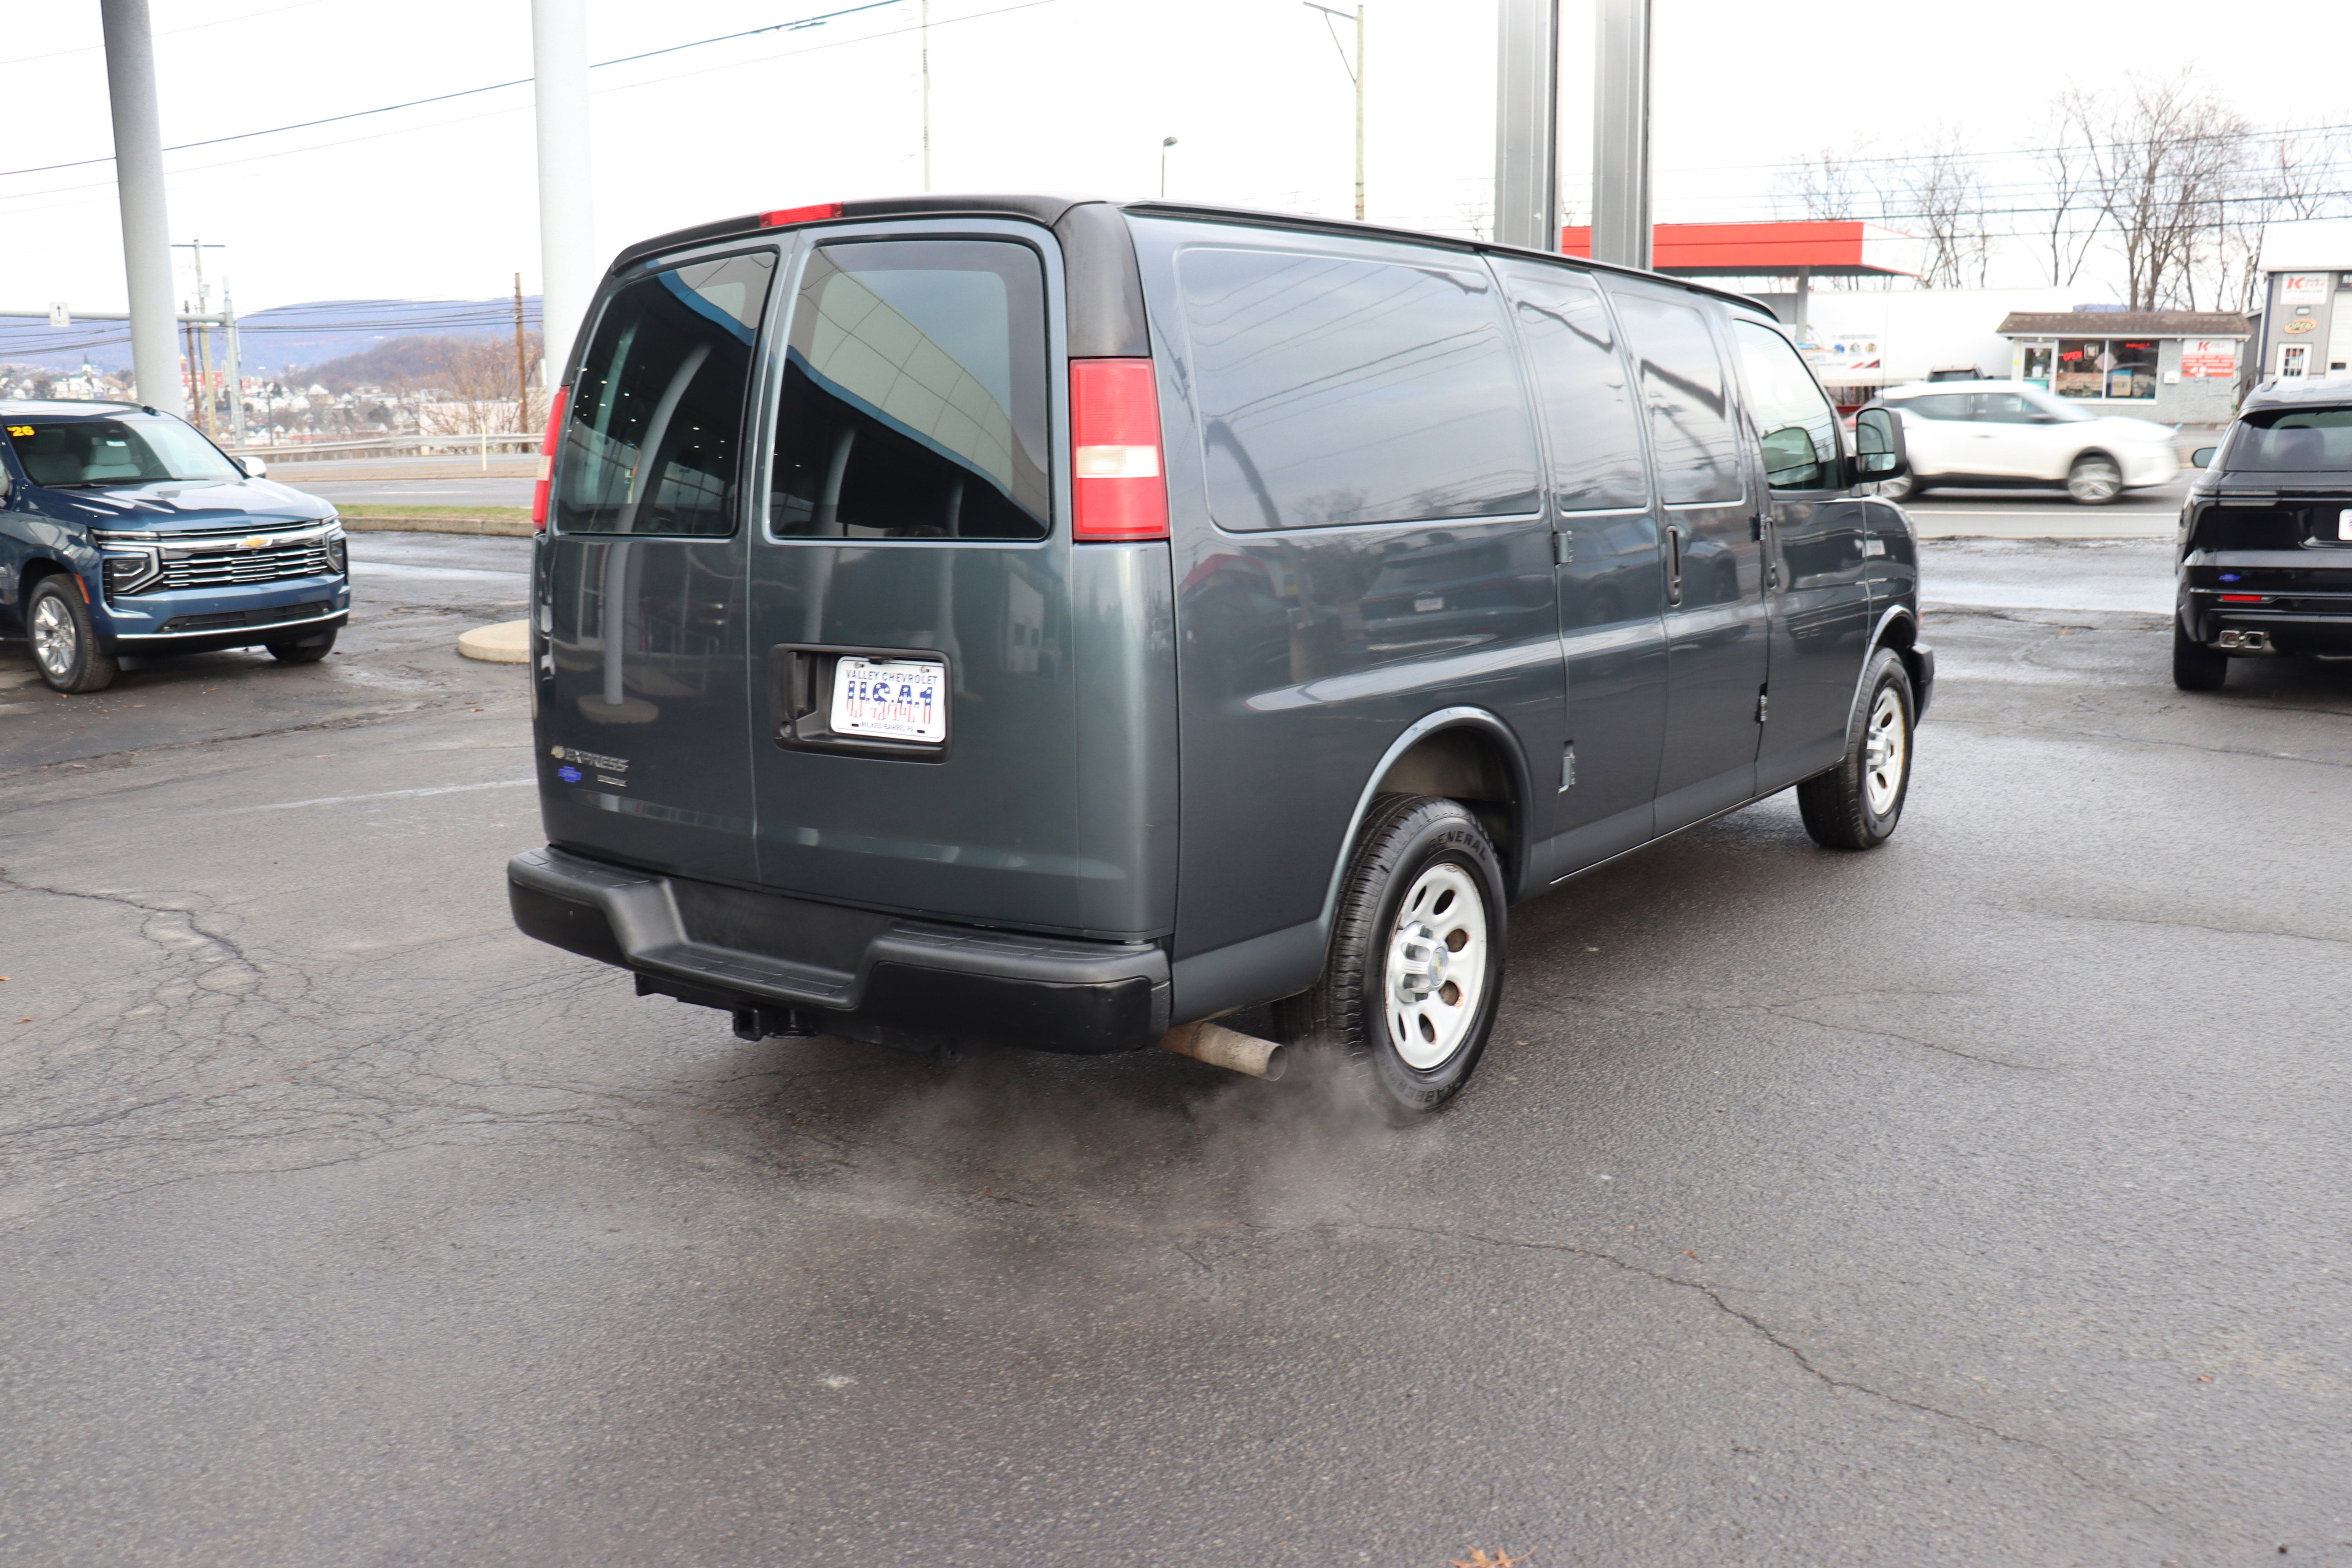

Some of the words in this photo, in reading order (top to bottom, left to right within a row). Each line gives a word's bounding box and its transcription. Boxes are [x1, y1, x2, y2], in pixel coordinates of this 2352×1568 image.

[2062, 351, 2082, 361] OPEN
[846, 669, 879, 681] VALLEY
[882, 672, 938, 684] CHEVROLET
[565, 748, 630, 773] EXPRESS
[1427, 830, 1487, 861] GENERAL
